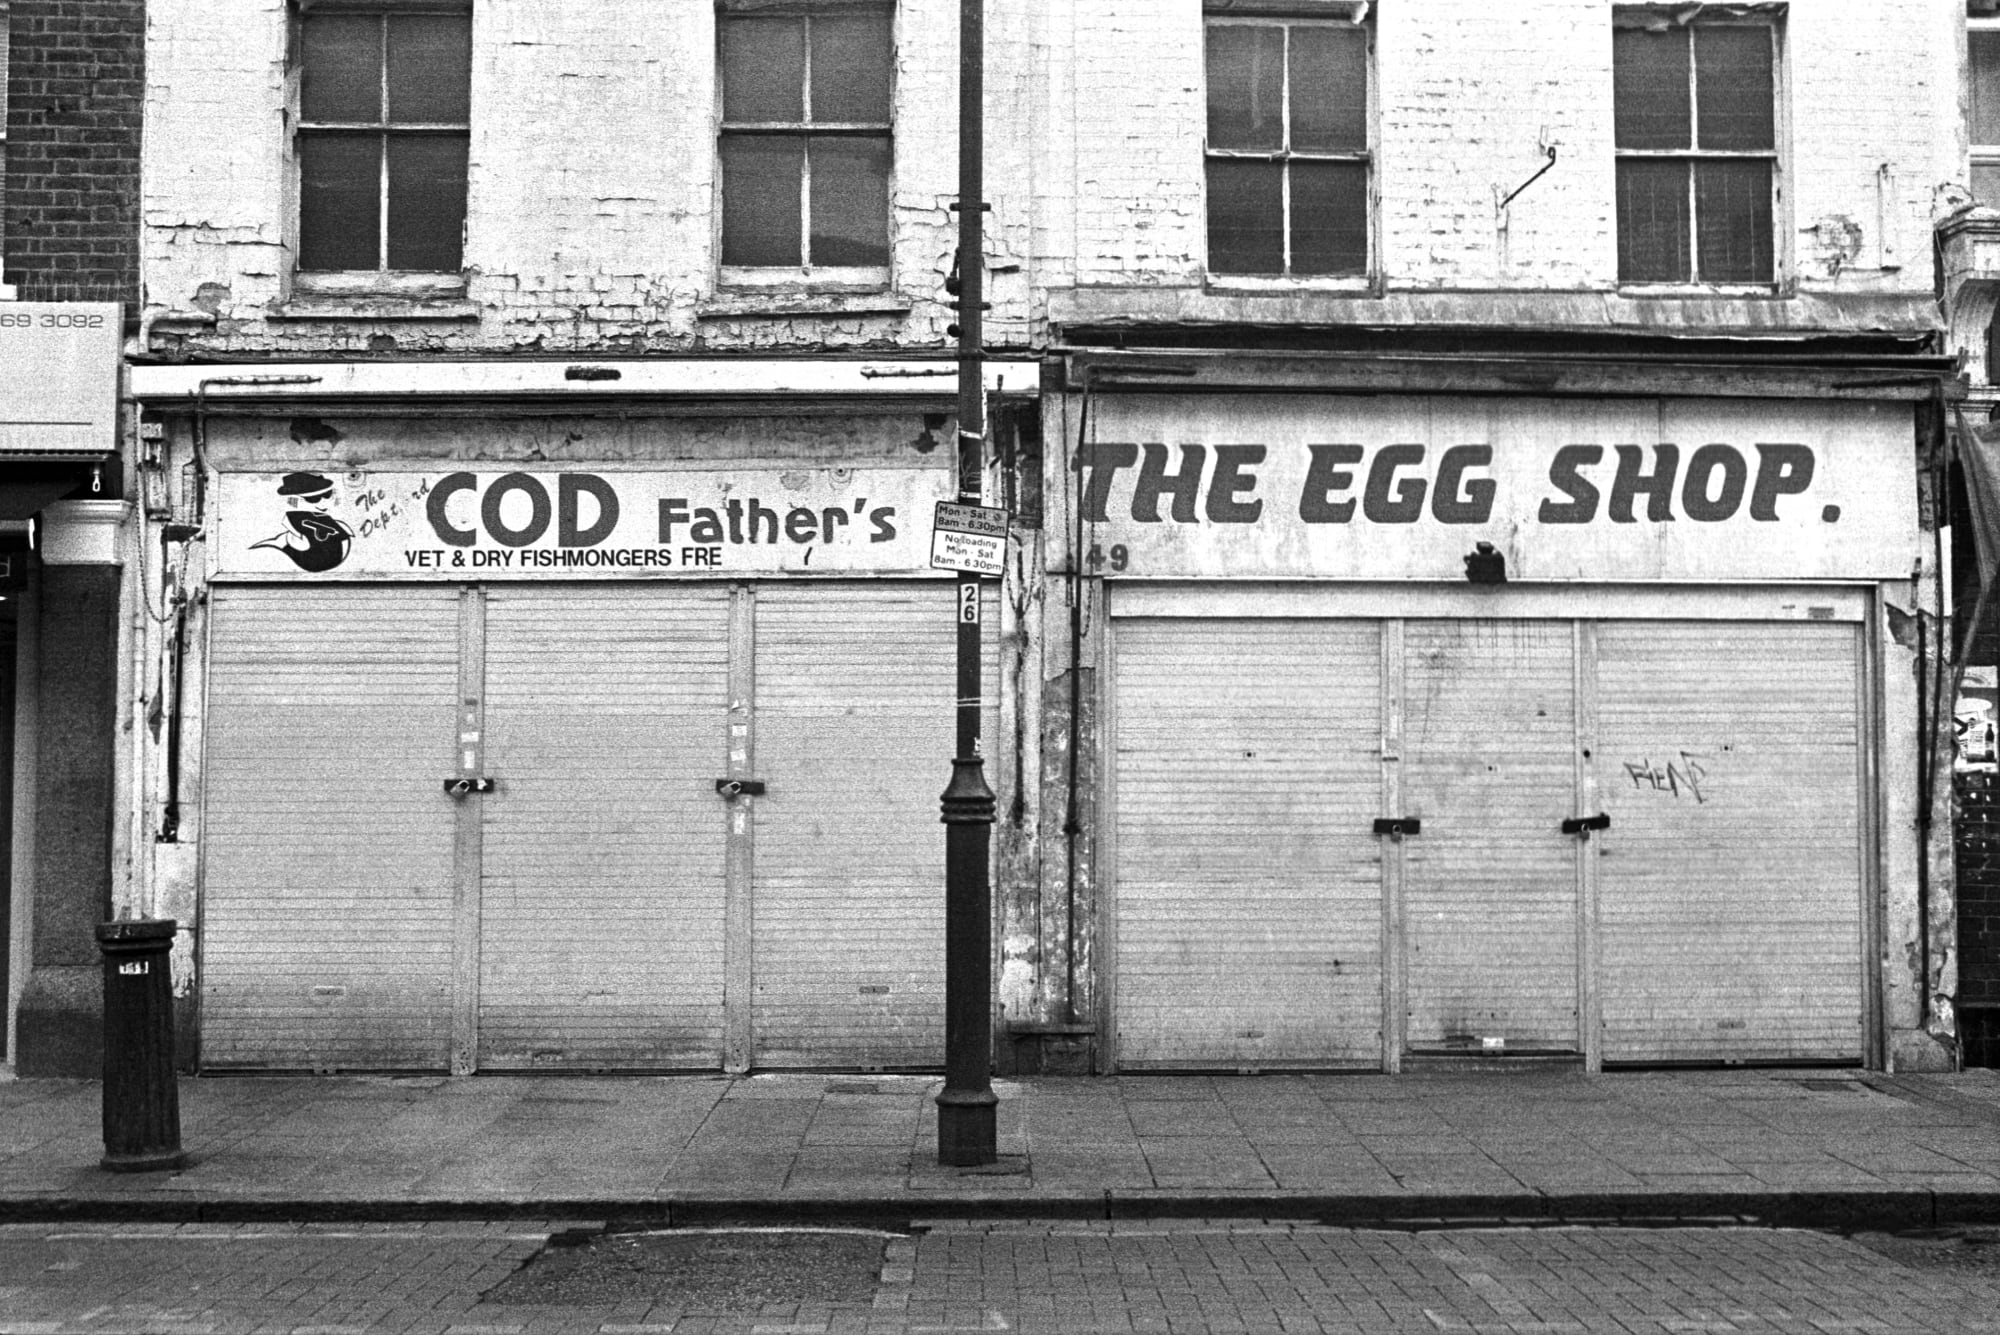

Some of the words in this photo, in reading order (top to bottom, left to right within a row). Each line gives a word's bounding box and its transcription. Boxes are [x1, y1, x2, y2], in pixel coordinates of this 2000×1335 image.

[40, 314, 103, 328] 3092
[1071, 443, 1267, 523] THE
[1299, 444, 1496, 524] EGG
[1538, 443, 1841, 524] SHOP.
[355, 489, 385, 512] The
[426, 471, 620, 548] COD
[658, 498, 897, 544] Father's
[939, 506, 960, 516] Mon
[970, 510, 987, 519] Sat
[938, 517, 959, 527] 8am
[968, 520, 1005, 533] 6.30pm
[945, 534, 960, 544] No
[452, 549, 465, 567] &
[473, 549, 514, 566] DRY
[521, 548, 672, 567] FISHMONGERS
[946, 545, 967, 555] Mon
[977, 549, 994, 559] Sat
[934, 555, 955, 565] 8am
[964, 558, 1001, 570] 630pm
